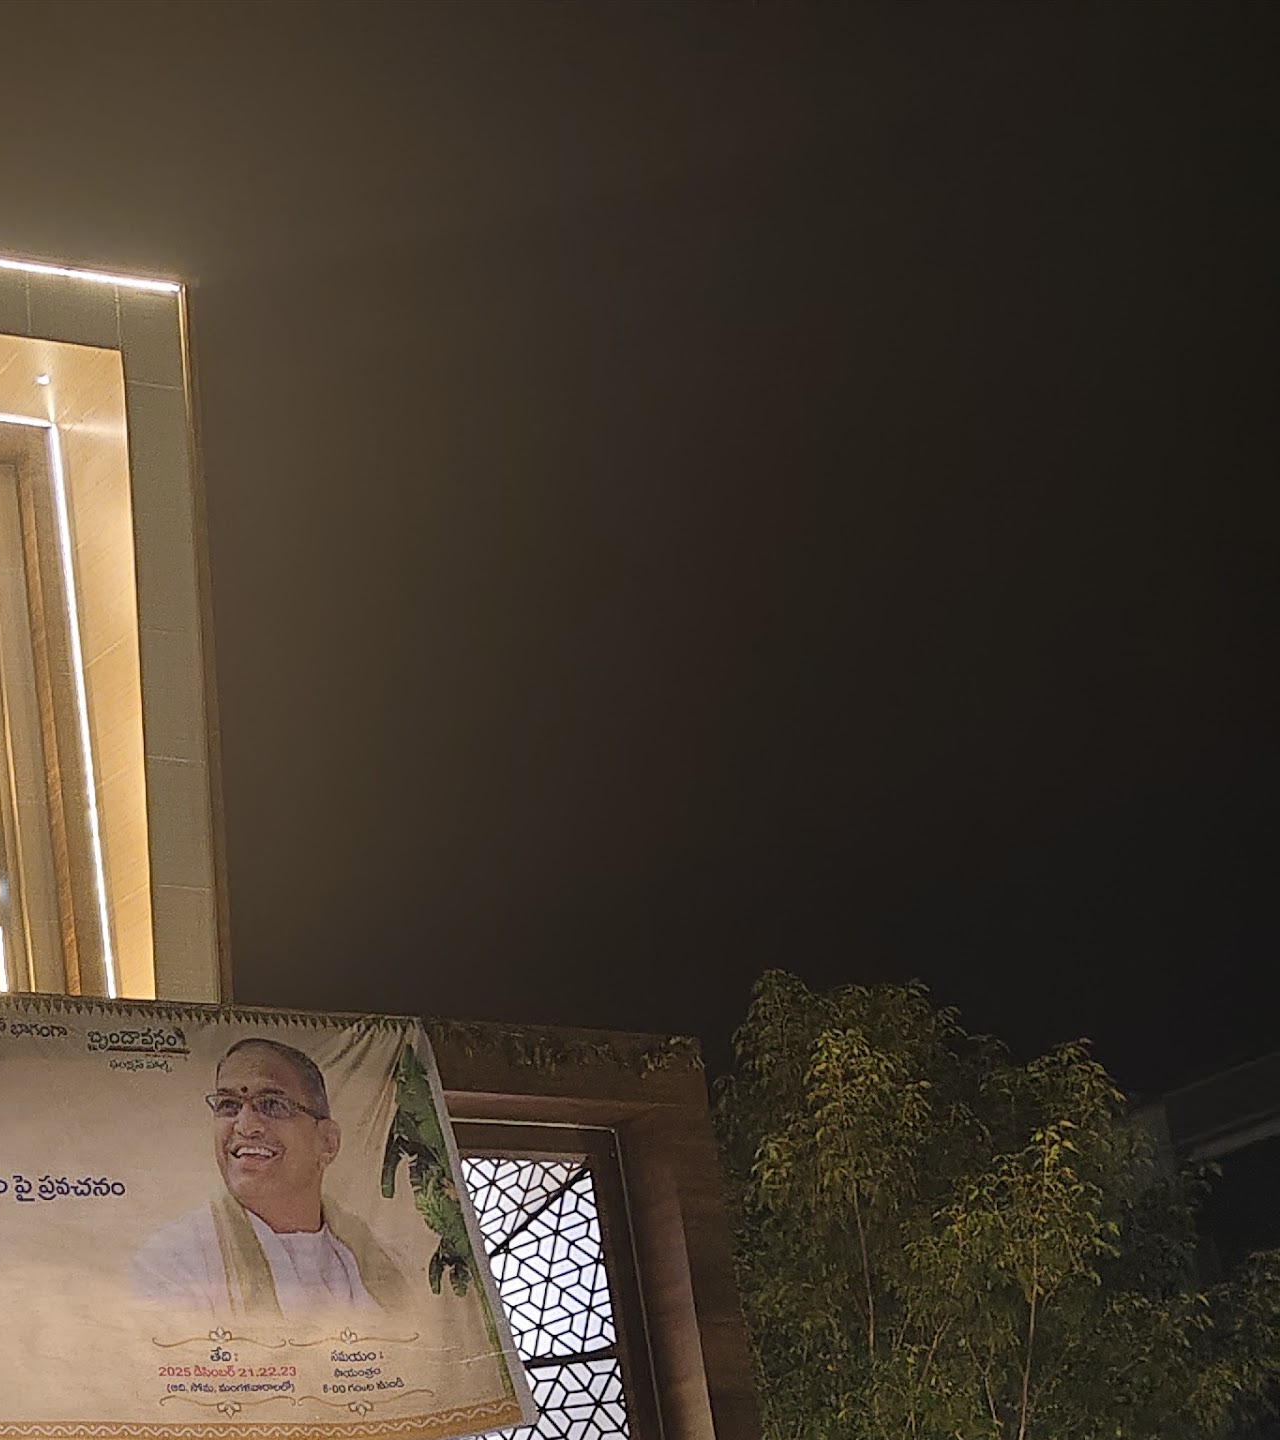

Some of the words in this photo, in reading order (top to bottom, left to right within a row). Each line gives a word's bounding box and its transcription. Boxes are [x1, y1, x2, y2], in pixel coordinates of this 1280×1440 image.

[11, 1022, 68, 1038] భాగంగా
[13, 1175, 35, 1201] పై
[38, 1178, 126, 1199] ప్రవచనం
[159, 1366, 191, 1377] 2025
